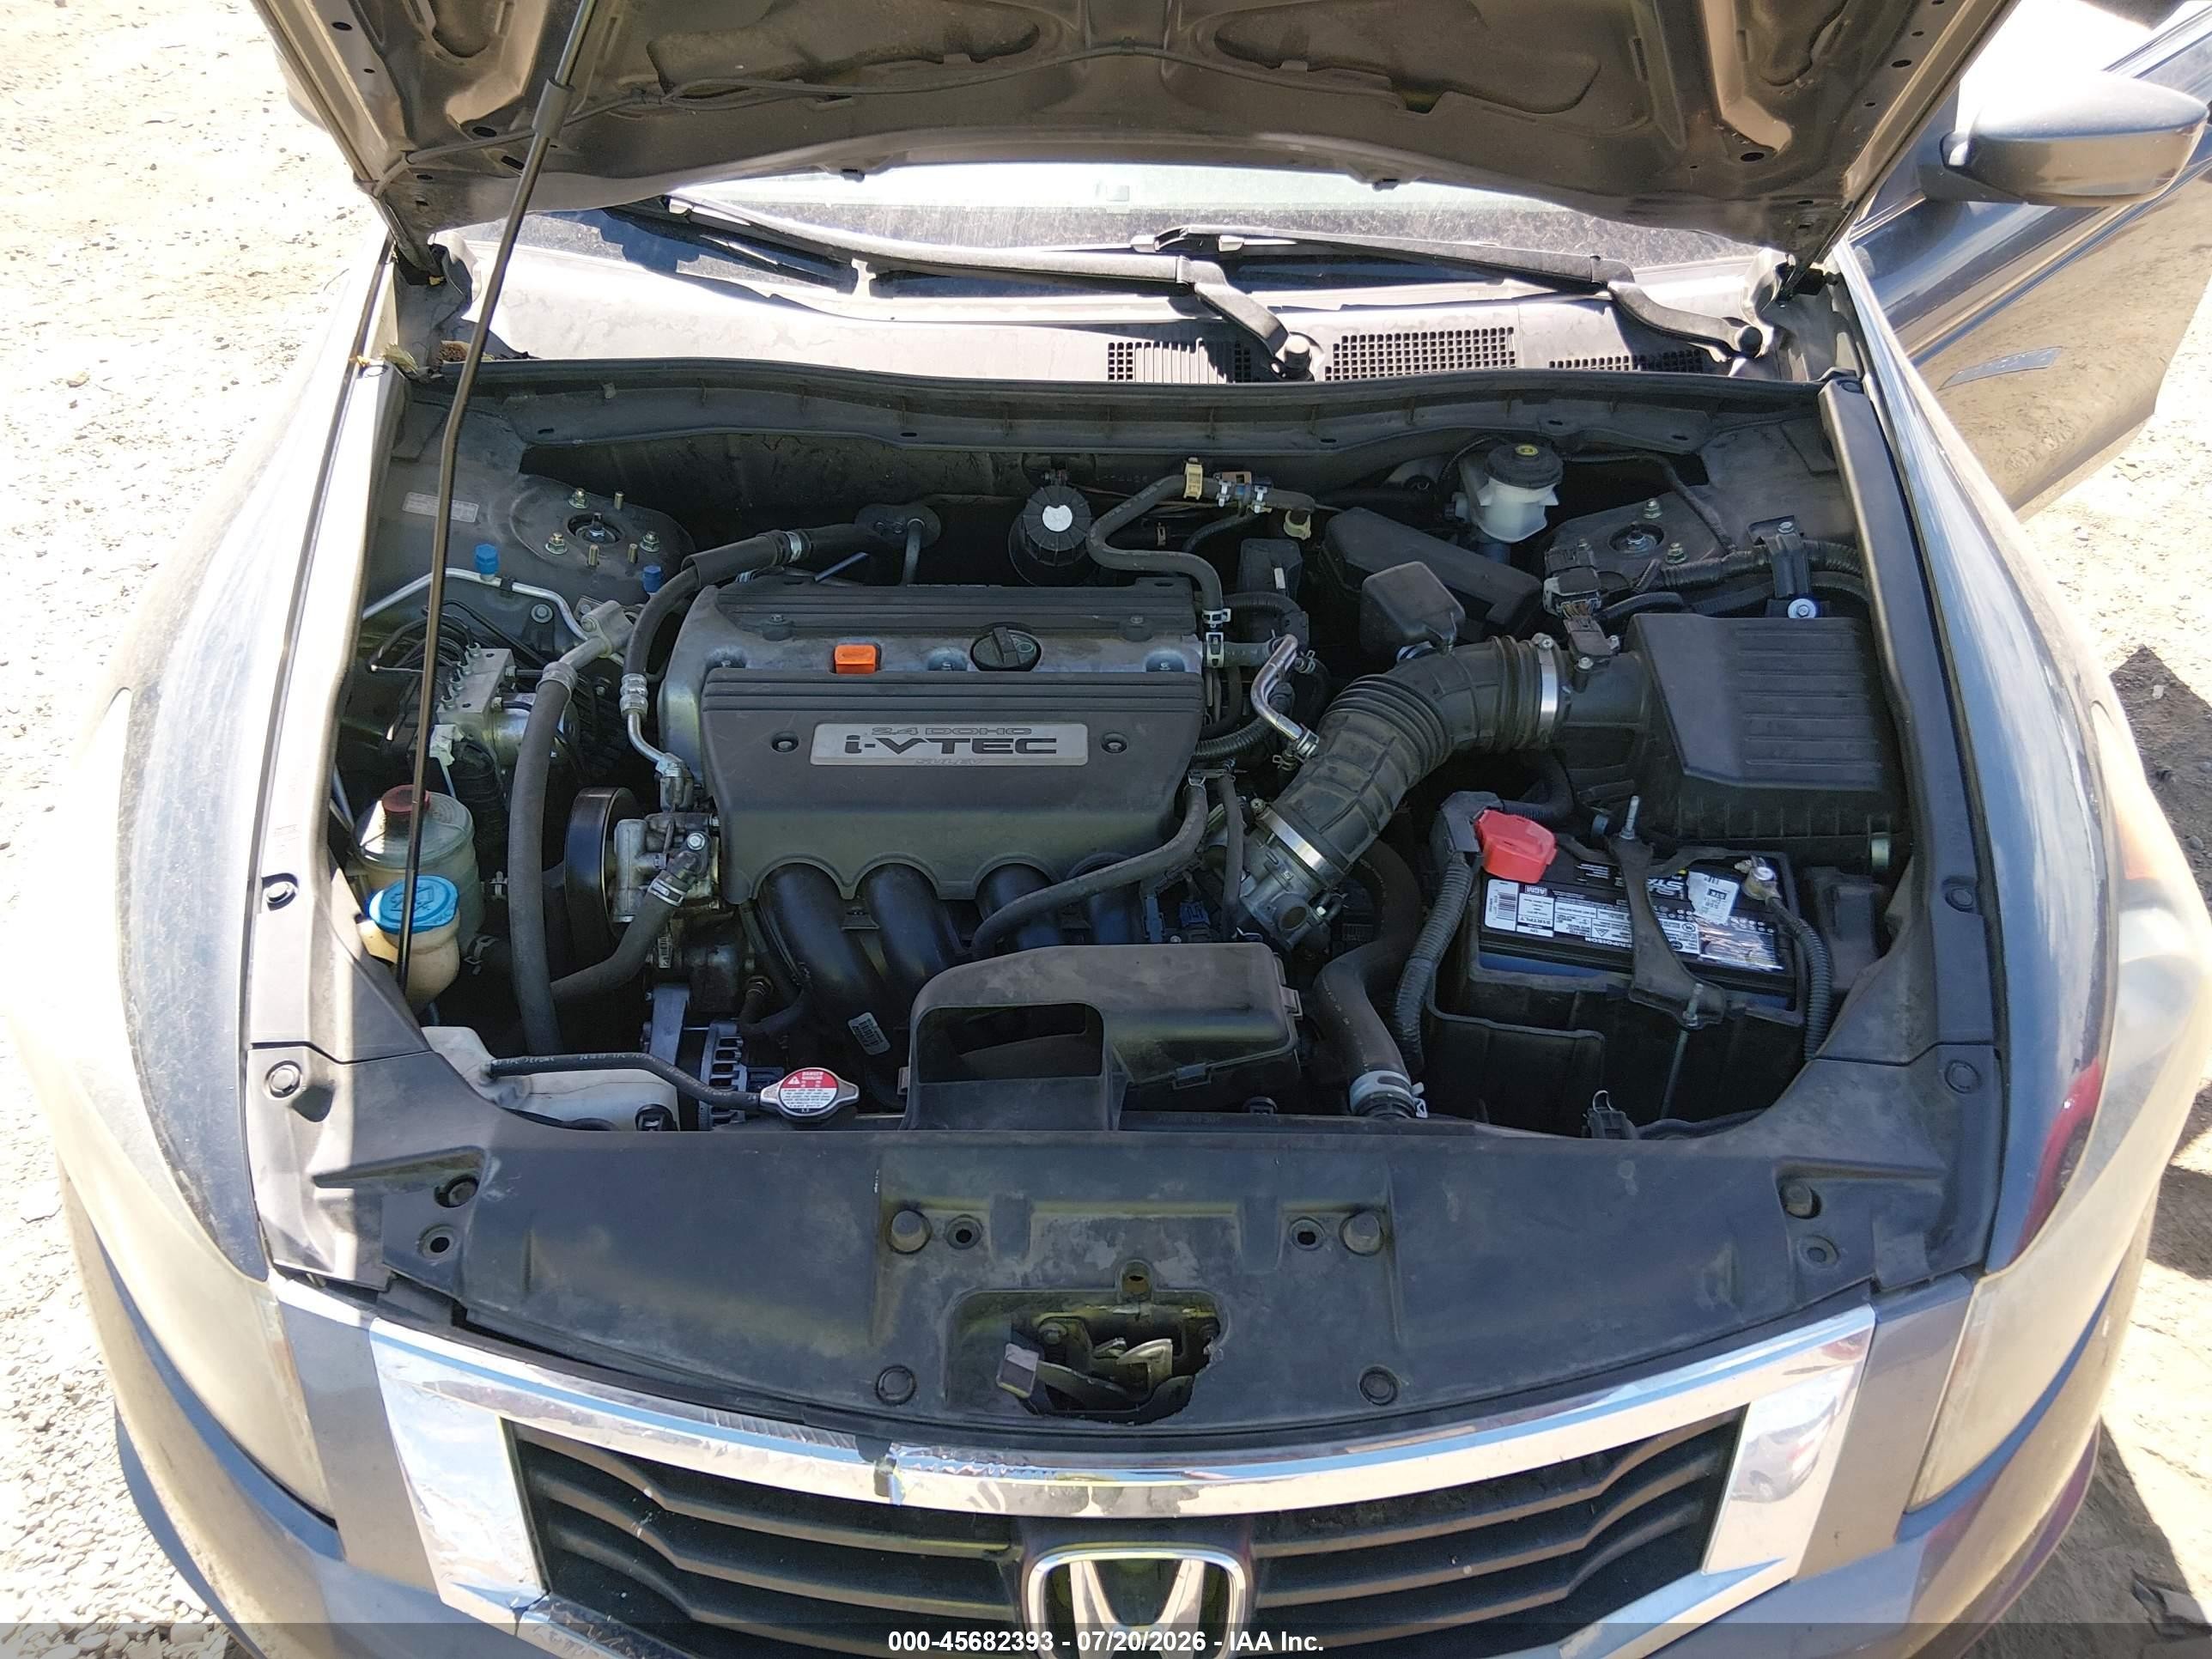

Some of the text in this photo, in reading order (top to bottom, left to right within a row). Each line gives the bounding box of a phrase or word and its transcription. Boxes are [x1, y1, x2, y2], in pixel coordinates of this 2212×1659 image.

[872, 726, 1032, 736] 2.4 DOHC
[844, 734, 1057, 755] i-VTEC
[1527, 886, 1547, 896] AGM
